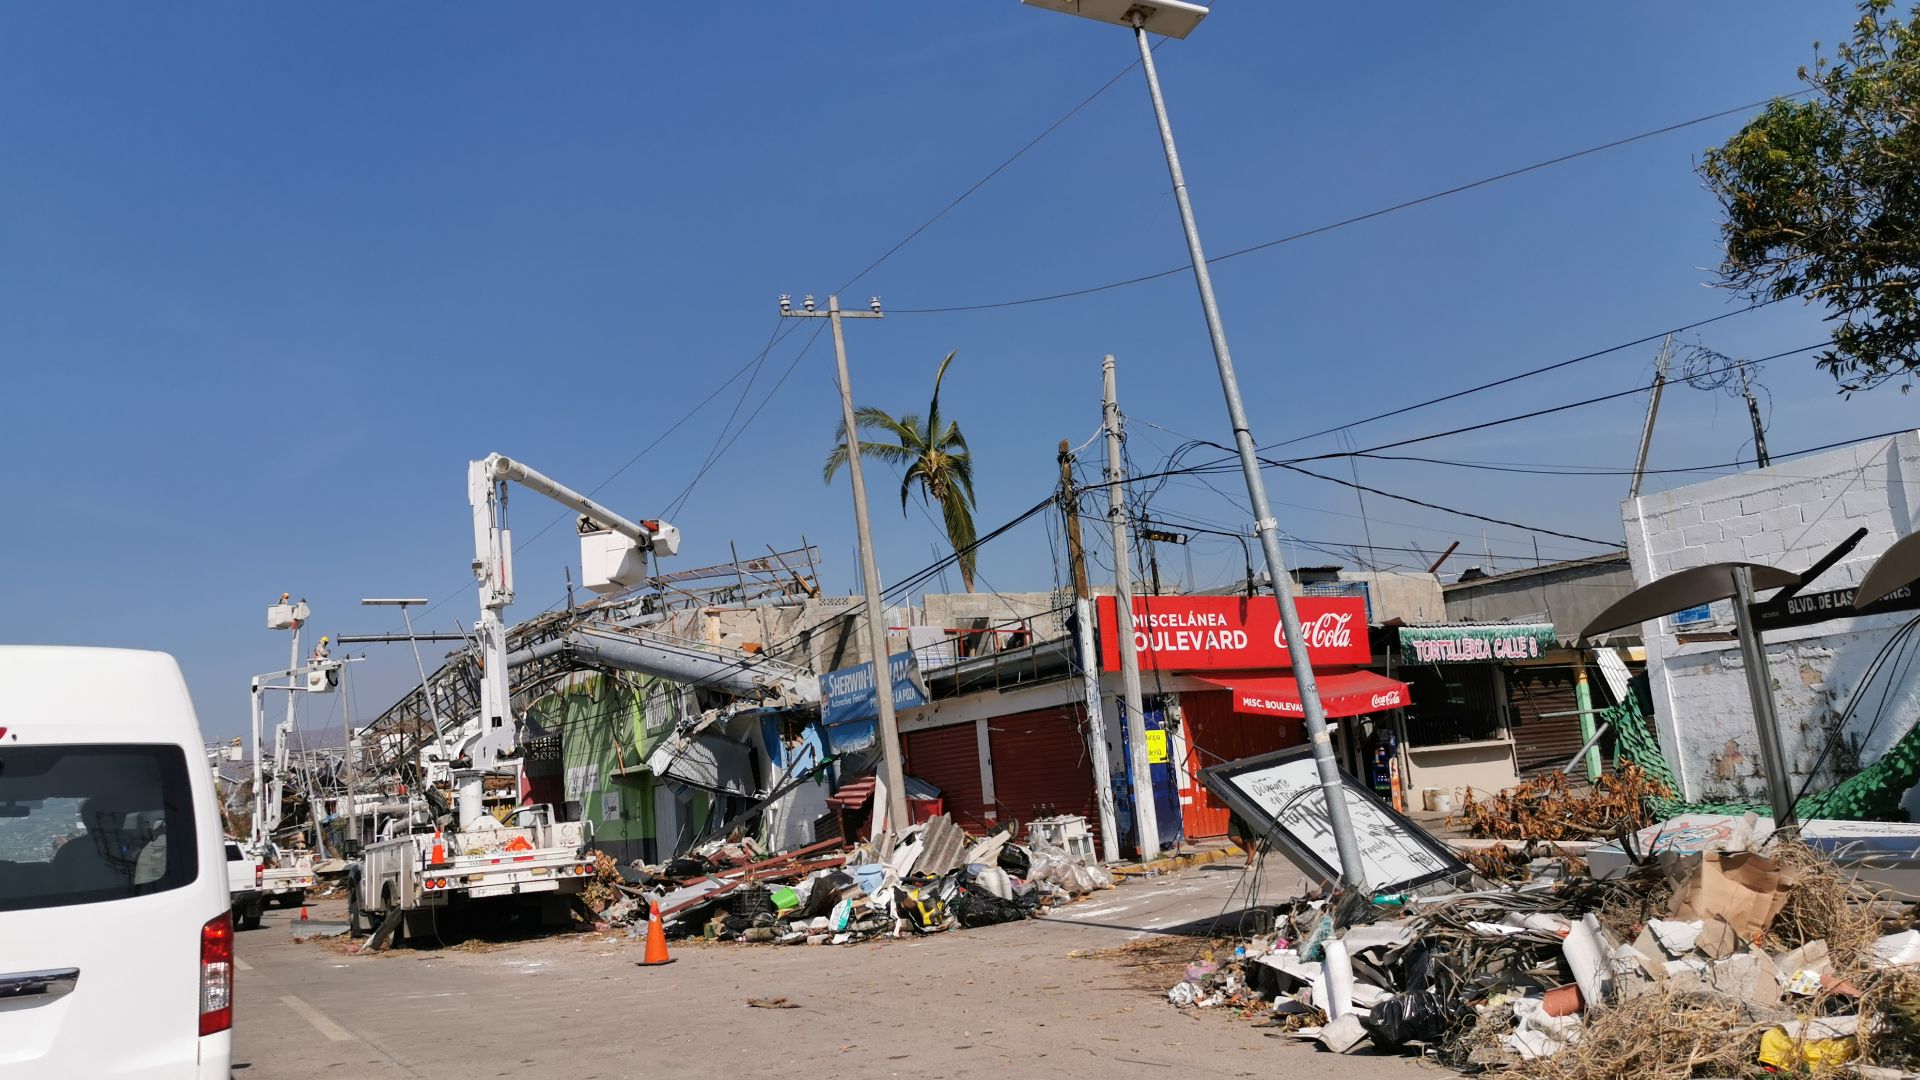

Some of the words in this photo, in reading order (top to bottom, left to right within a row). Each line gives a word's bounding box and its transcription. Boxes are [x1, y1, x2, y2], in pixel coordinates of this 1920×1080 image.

[1787, 597, 1817, 614] BLVD.
[1818, 594, 1832, 610] DE
[1833, 590, 1854, 608] LAS
[1132, 610, 1228, 628] MISCELÁNEA
[1134, 629, 1248, 652] OULEVARD
[1413, 637, 1493, 662] TORTILLERIA
[1493, 636, 1528, 659] CALLE
[1528, 636, 1538, 658] 8
[895, 689, 903, 703] LA
[903, 687, 916, 701] POZA
[1242, 697, 1265, 708] MISC.
